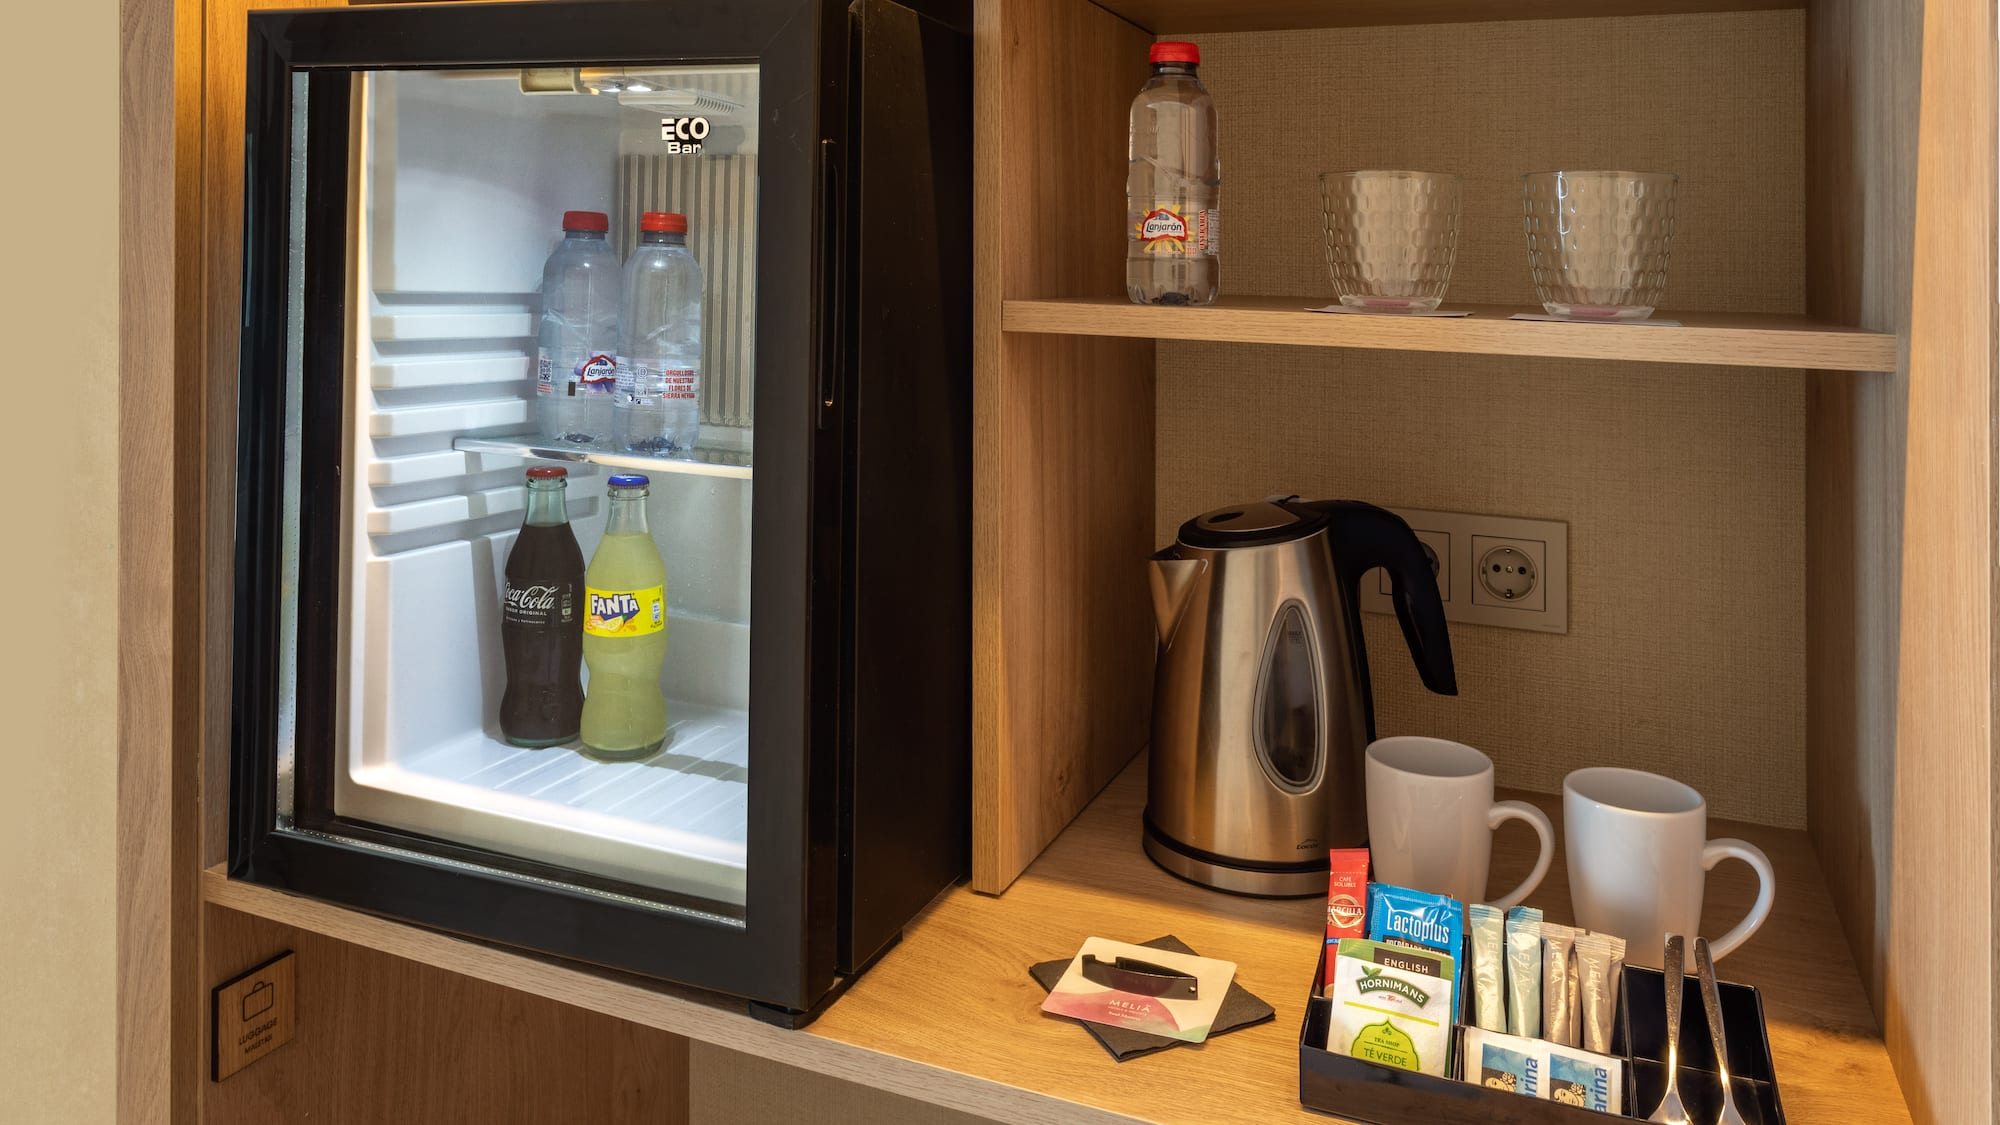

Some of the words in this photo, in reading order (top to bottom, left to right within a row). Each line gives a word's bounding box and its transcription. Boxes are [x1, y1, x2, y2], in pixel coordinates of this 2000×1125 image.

[661, 117, 710, 141] ECO
[667, 141, 702, 154] Bar
[1146, 221, 1182, 233] Lanjarón
[587, 366, 615, 377] Lanjarón
[591, 594, 639, 615] FANTA
[1387, 909, 1450, 944] Lactoplus
[1384, 958, 1429, 974] ENGLISH
[1360, 979, 1425, 1003] HORNIMANS
[239, 1017, 278, 1045] LUGGAGE
[1374, 1036, 1385, 1045] TEA
[1385, 1038, 1400, 1047] SHOP
[1364, 1046, 1375, 1059] TÉ
[1376, 1051, 1407, 1066] VERDE
